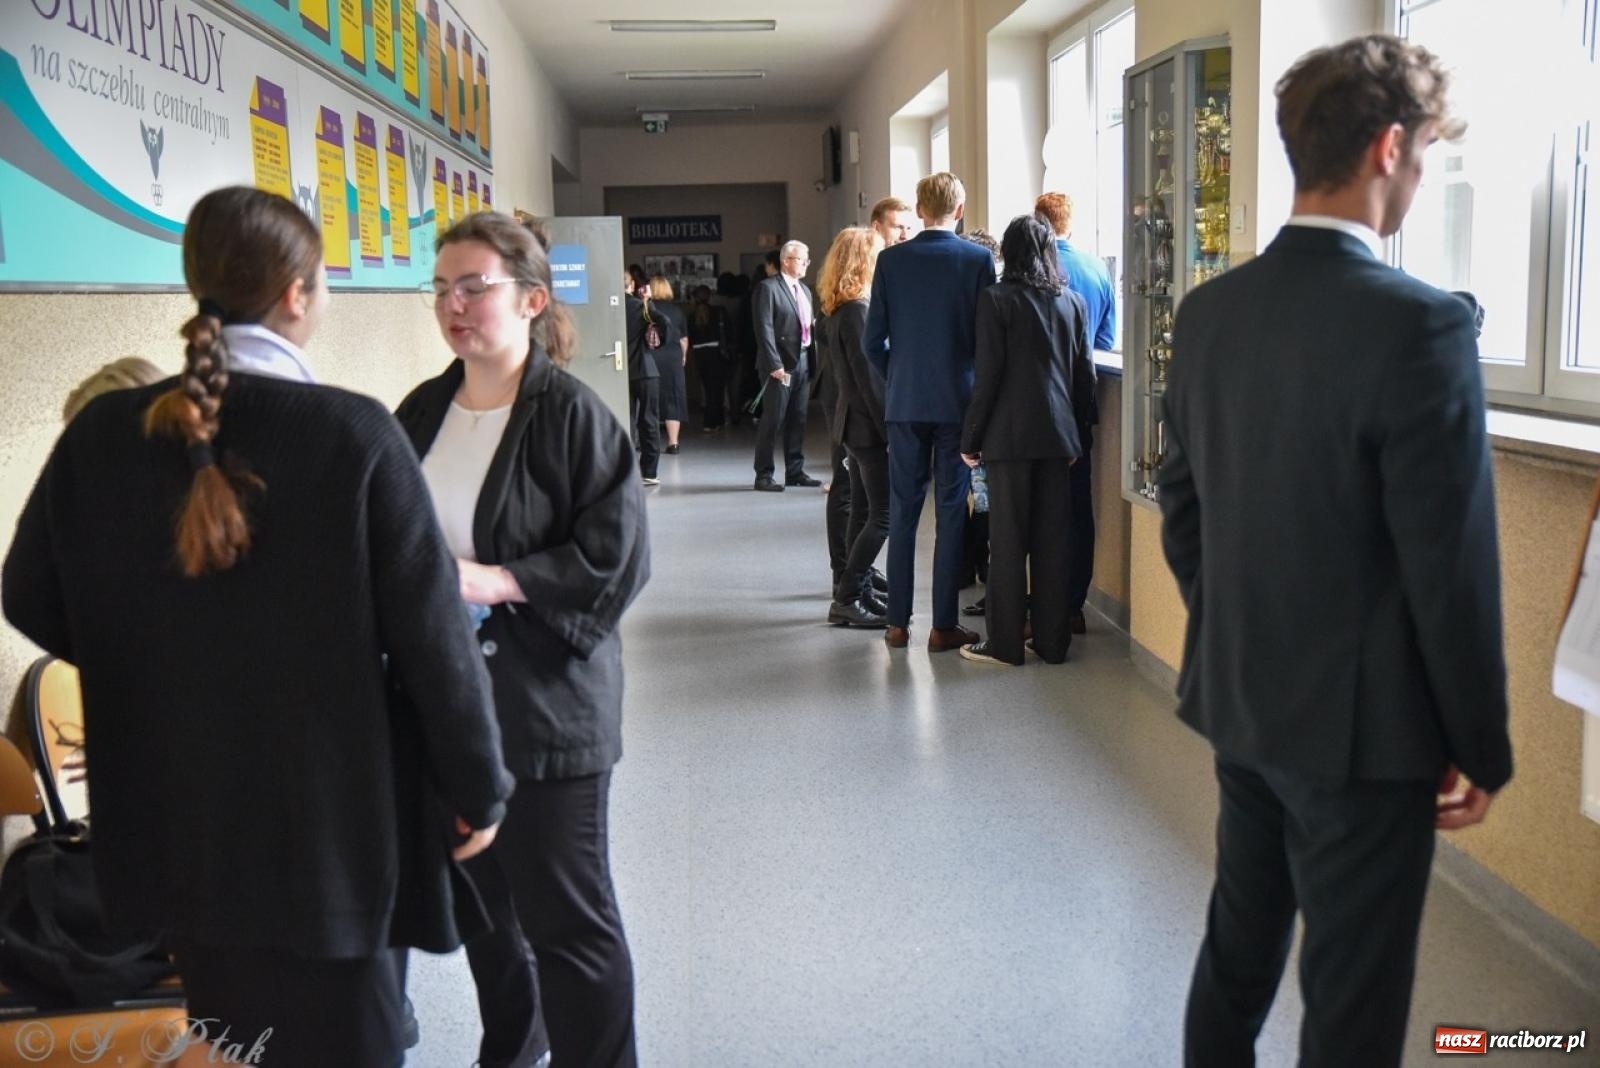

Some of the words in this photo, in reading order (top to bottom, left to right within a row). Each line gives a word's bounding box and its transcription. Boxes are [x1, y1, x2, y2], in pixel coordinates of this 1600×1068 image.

[32, 0, 226, 93] LIMPIADY
[31, 43, 61, 82] na
[67, 57, 146, 111] szczeblu
[153, 89, 230, 145] centralnym
[632, 222, 719, 239] BIBLIOTEKA
